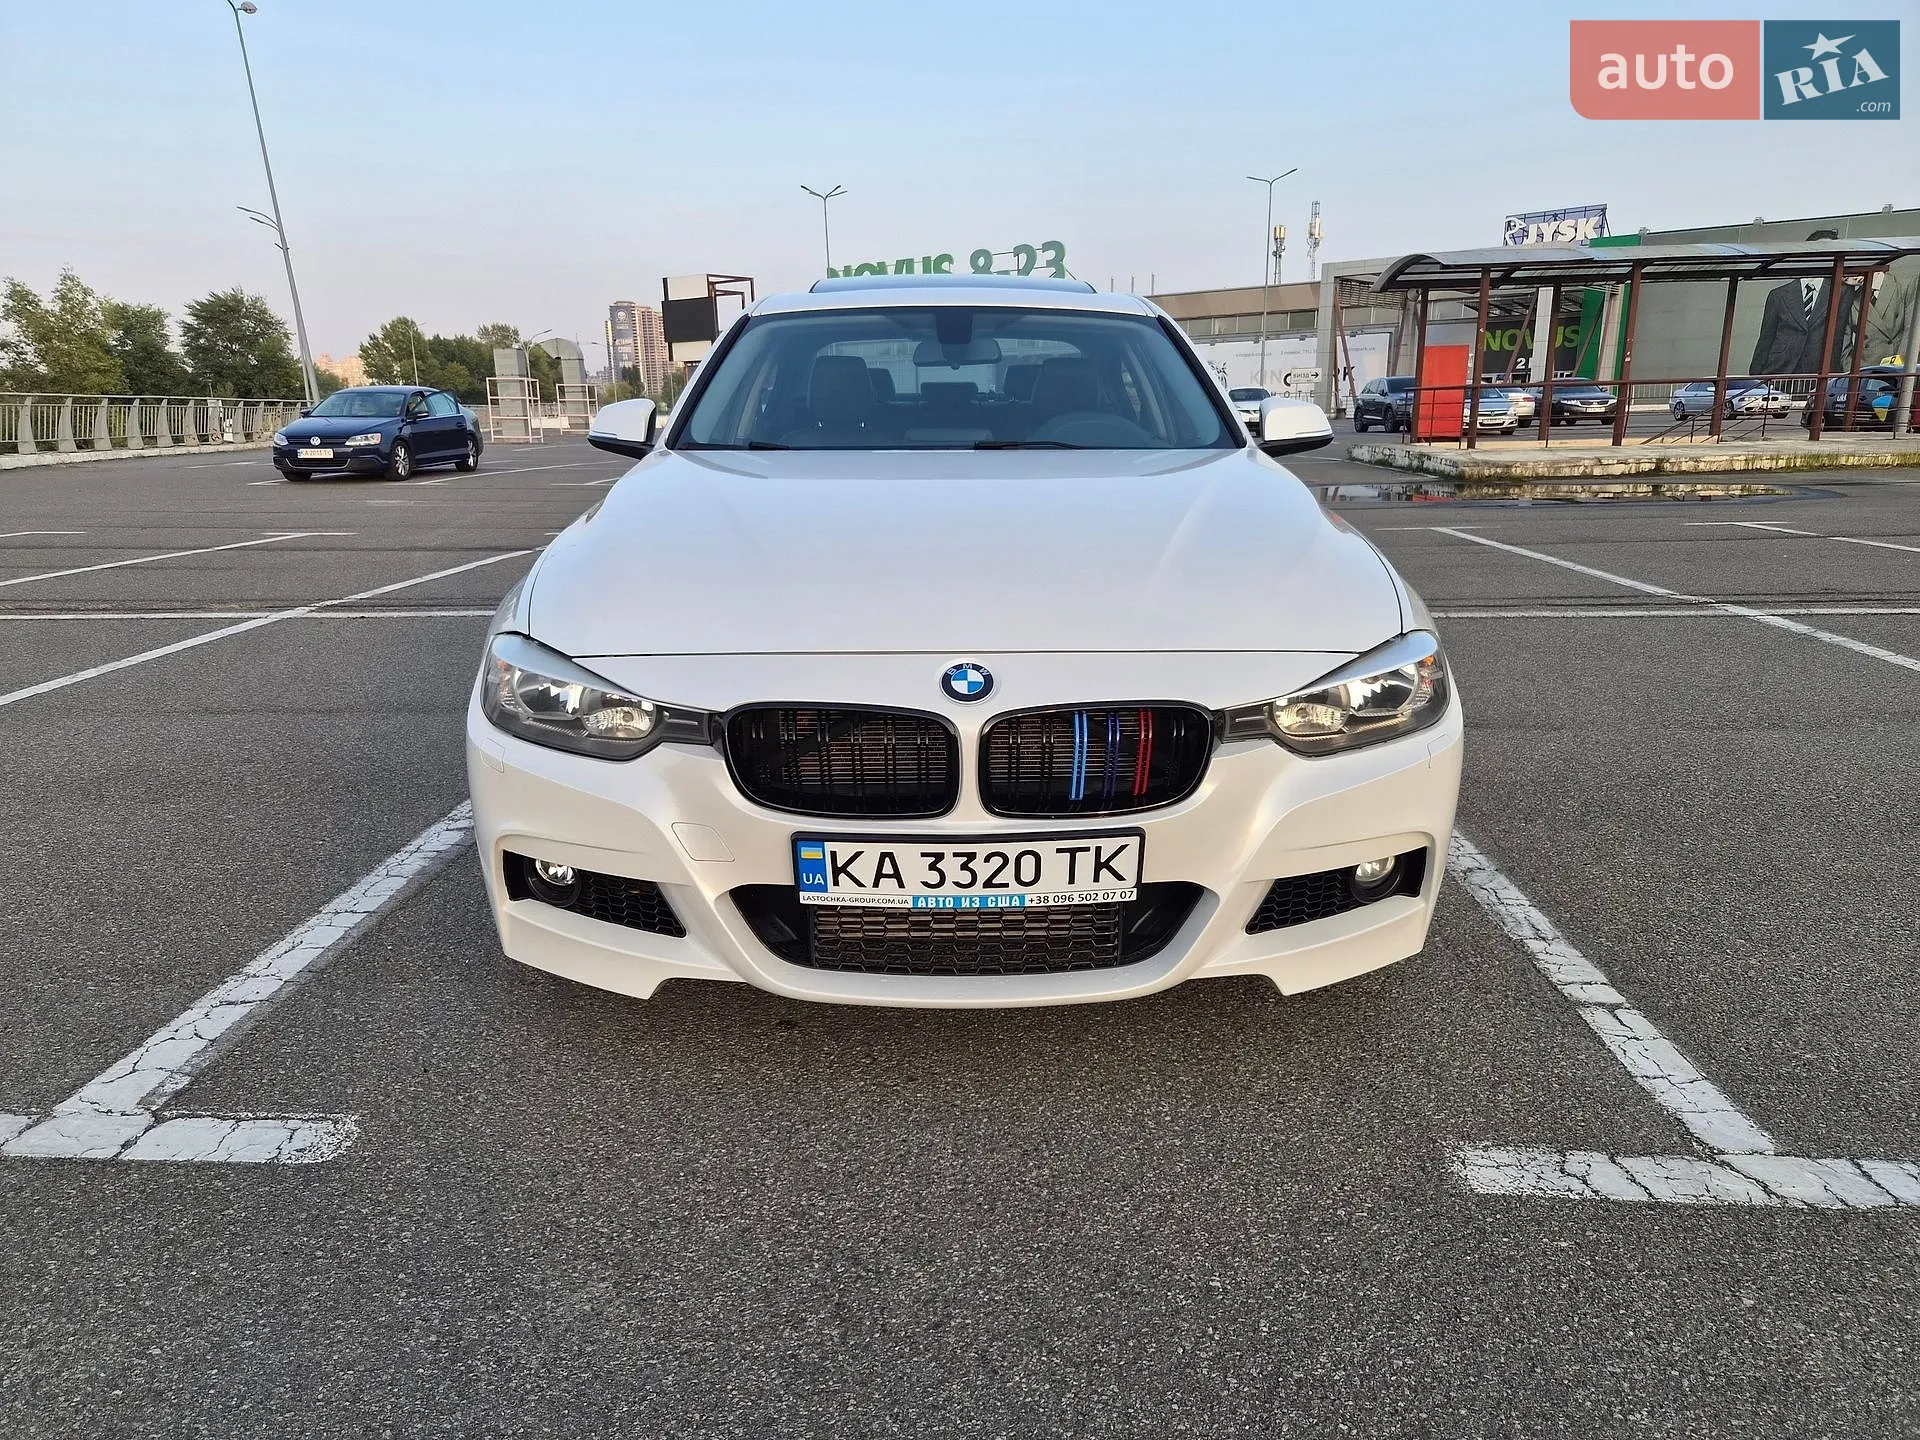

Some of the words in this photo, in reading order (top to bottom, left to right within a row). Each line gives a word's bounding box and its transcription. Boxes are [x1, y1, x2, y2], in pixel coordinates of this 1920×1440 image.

[1524, 216, 1600, 245] JYSK
[946, 663, 990, 676] BMW
[829, 850, 906, 889] KA
[920, 850, 1042, 889] 3320
[1056, 843, 1131, 885] TK
[803, 873, 825, 885] UA
[802, 895, 909, 905] LASTOCHKA-GROUP.COM.UA
[917, 897, 954, 908] АВТО
[961, 896, 980, 908] ИЗ
[987, 896, 1020, 907] США
[1028, 894, 1050, 905] +38
[1053, 893, 1075, 904] 096
[1078, 892, 1099, 902] 502
[1102, 891, 1117, 901] 07
[1119, 890, 1134, 899] 07
